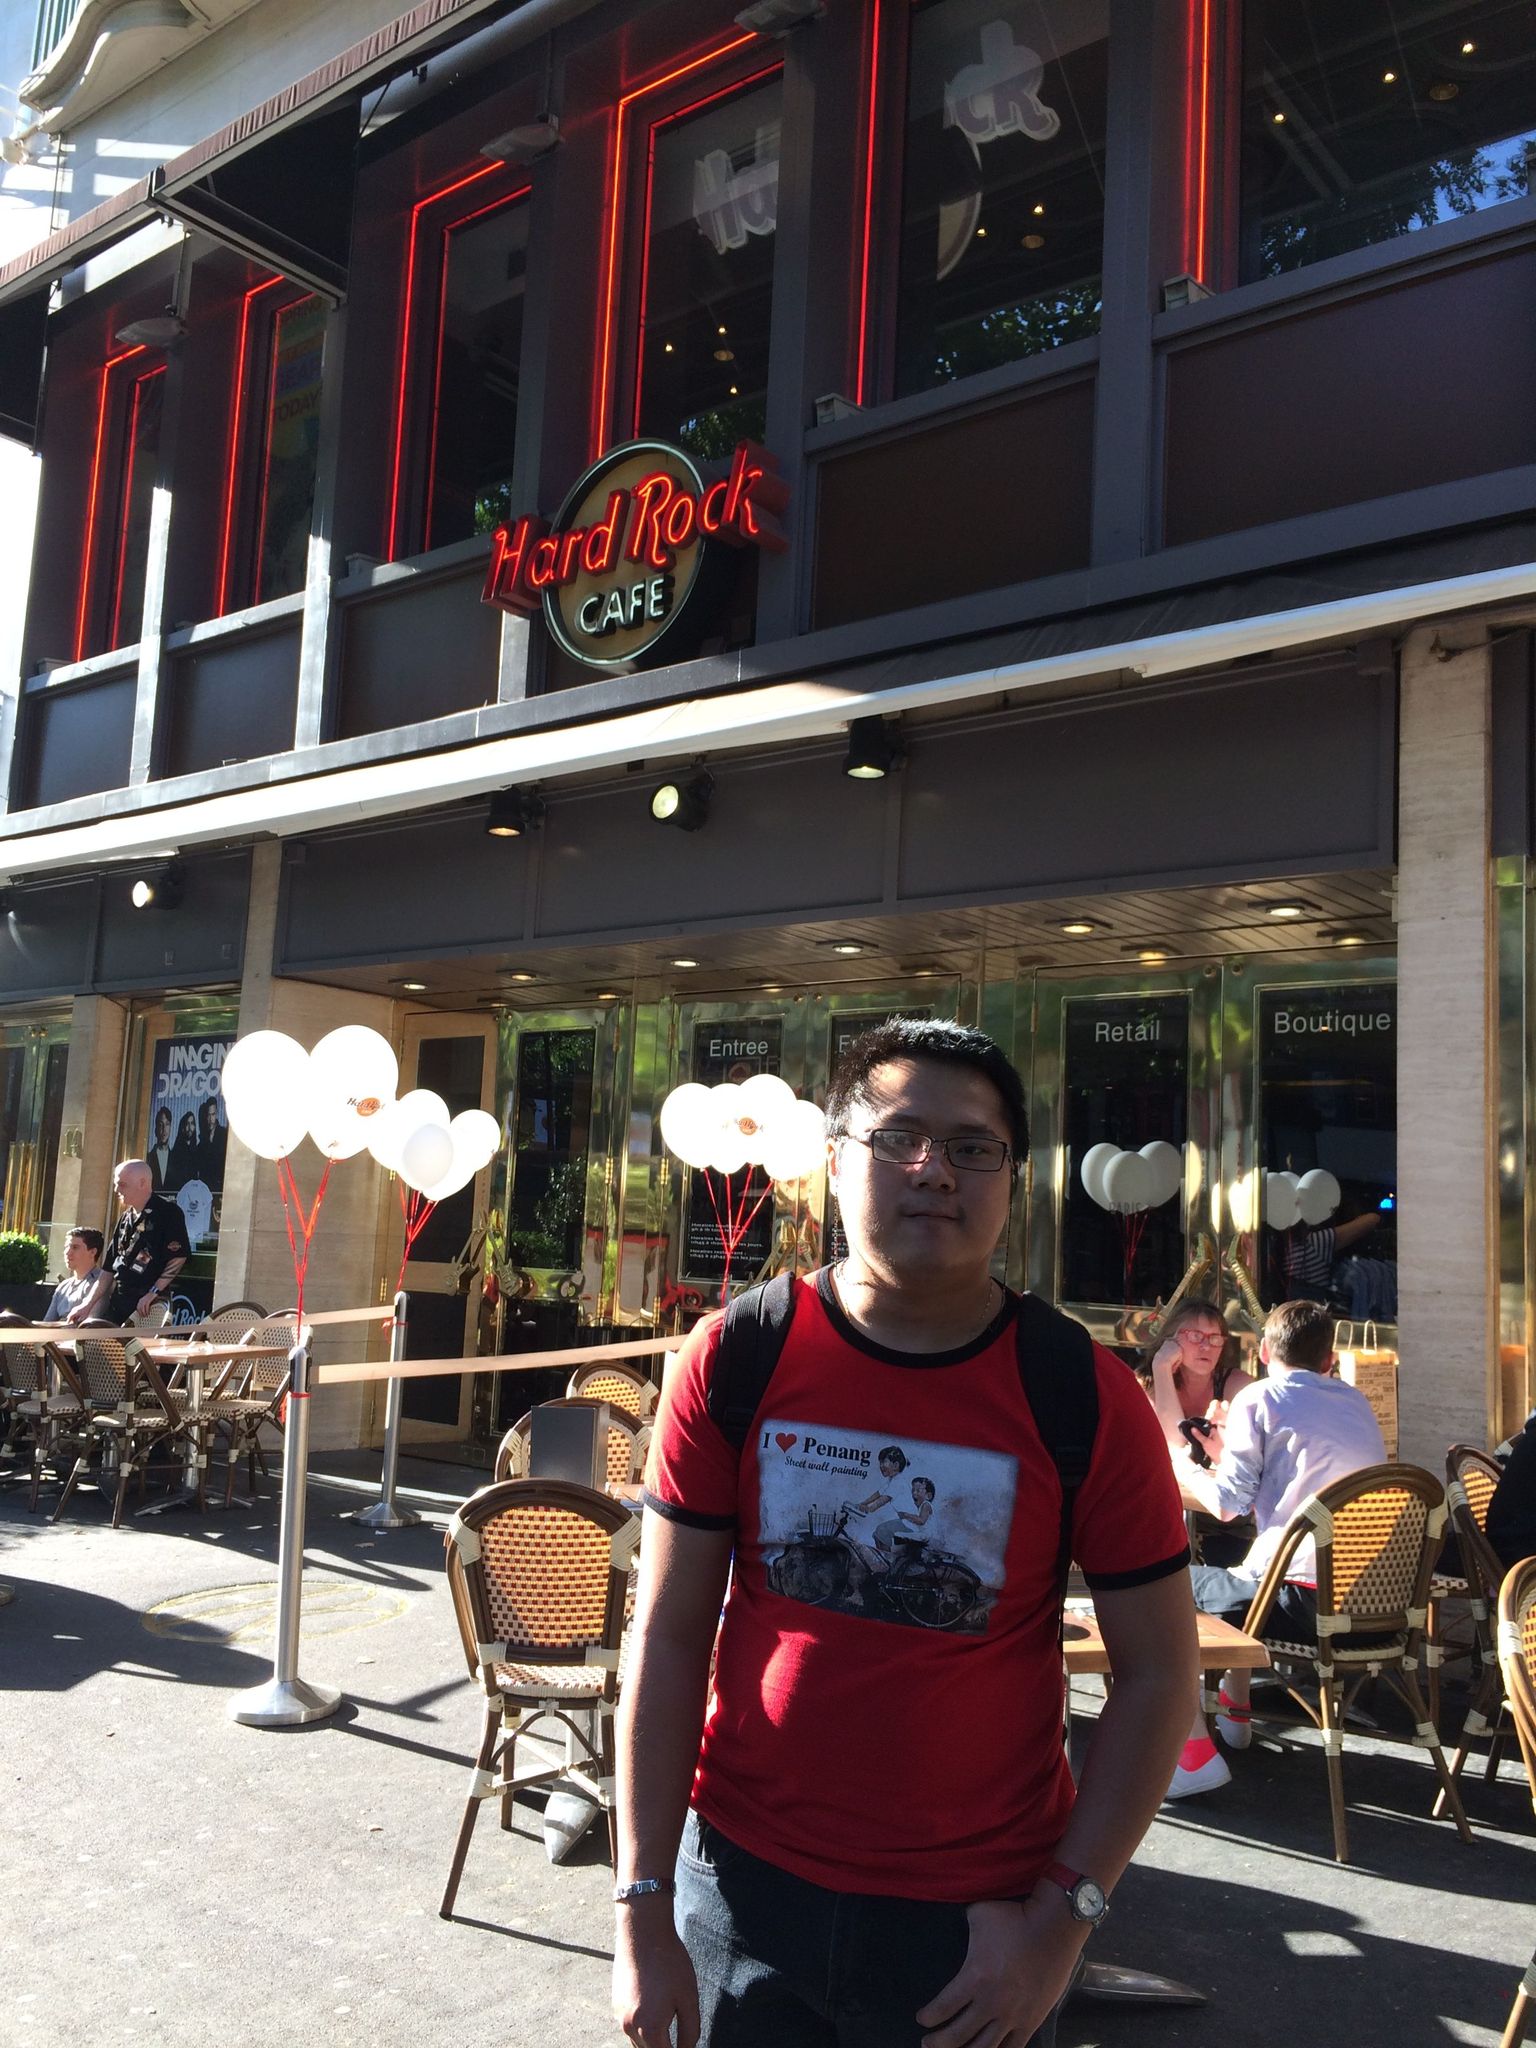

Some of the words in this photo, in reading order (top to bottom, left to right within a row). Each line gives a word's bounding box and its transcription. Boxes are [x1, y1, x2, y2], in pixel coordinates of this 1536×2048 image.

[481, 489, 630, 603] Hard
[625, 440, 768, 572] Rock
[576, 575, 670, 636] CAFE
[1095, 1020, 1161, 1043] Retail
[1274, 1010, 1392, 1037] Boutique
[168, 1042, 235, 1071] IMAGIN
[709, 1039, 769, 1057] Entree
[157, 1070, 223, 1098] DRAGO
[763, 1432, 770, 1448] I
[803, 1436, 872, 1468] Penang
[784, 1455, 806, 1469] Street
[808, 1460, 829, 1472] wall
[830, 1465, 868, 1480] painting
